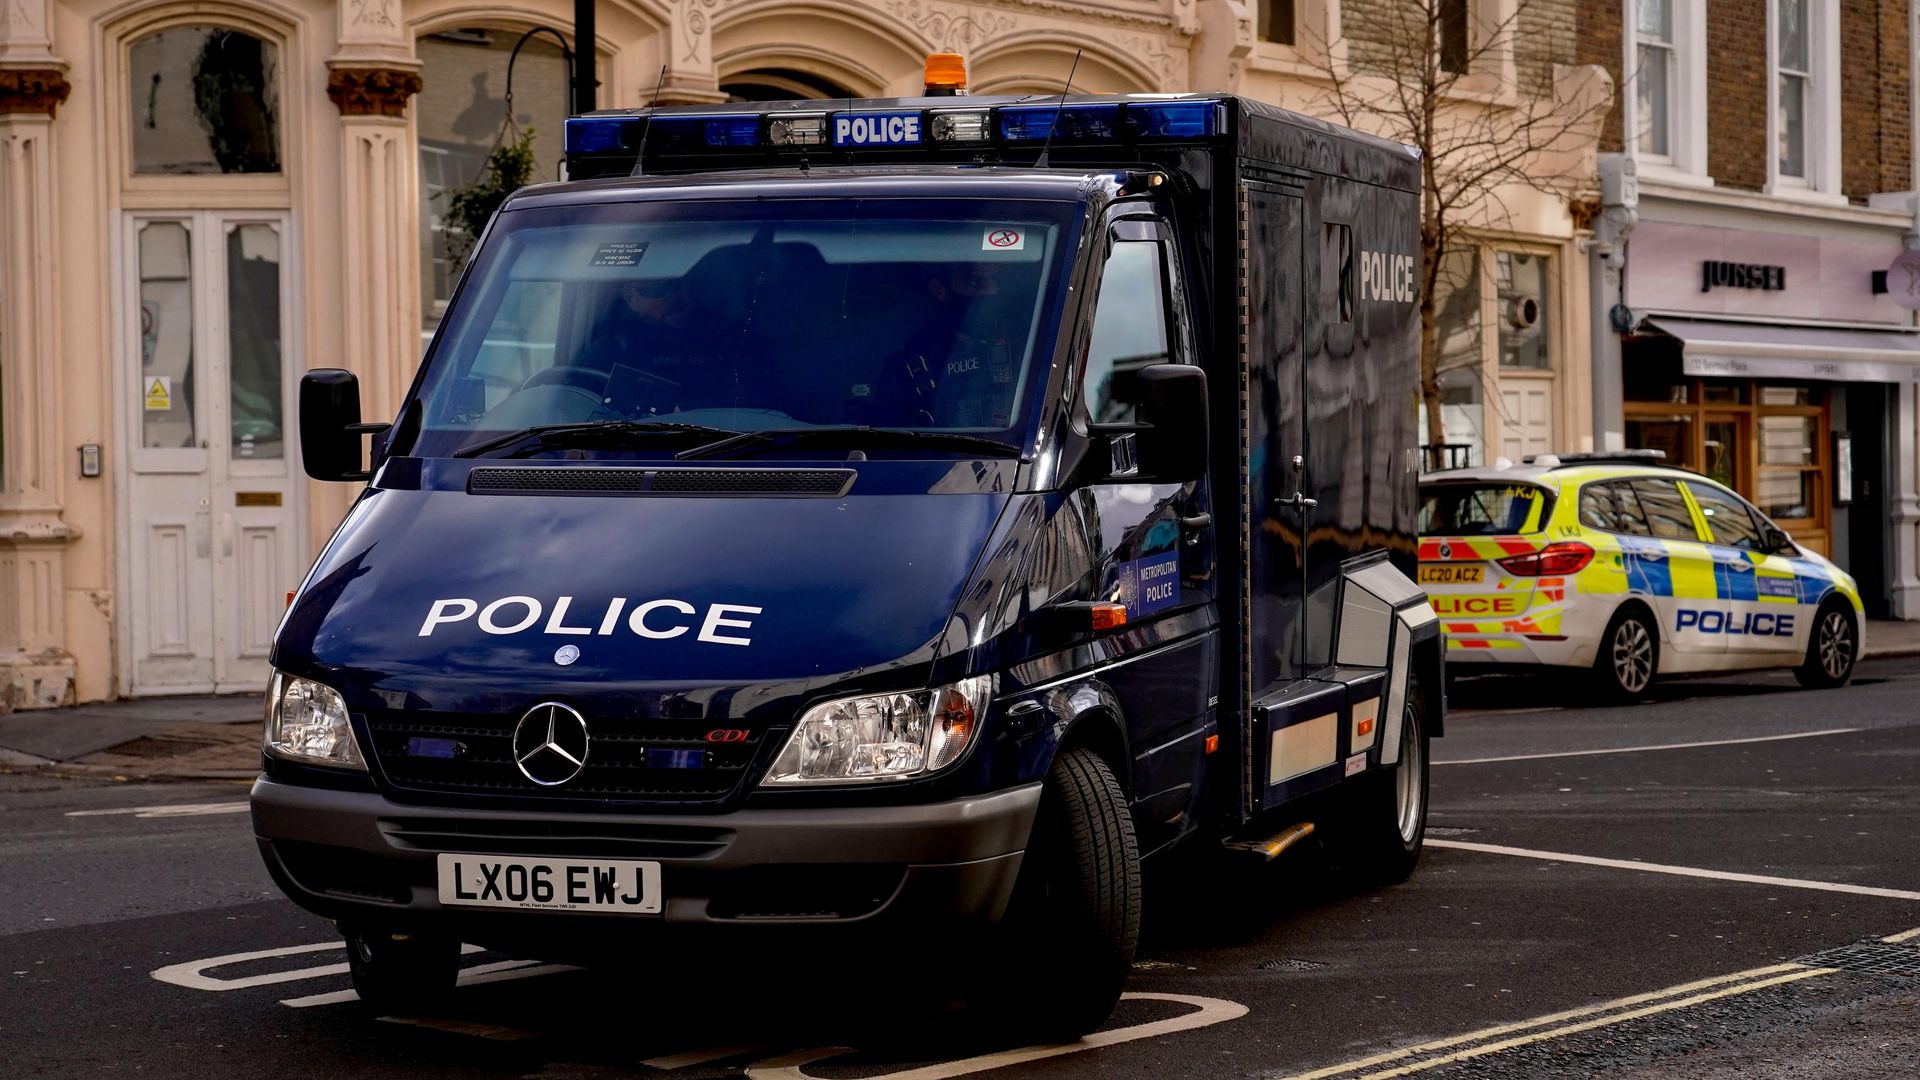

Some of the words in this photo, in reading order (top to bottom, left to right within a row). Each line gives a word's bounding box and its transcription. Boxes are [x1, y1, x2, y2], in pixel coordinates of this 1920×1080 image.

[837, 117, 919, 144] POLICE
[1361, 250, 1414, 303] POLICE
[947, 358, 980, 375] POLICE
[1559, 525, 1582, 537] LKJ
[1140, 560, 1177, 581] METROPOLITAN
[1421, 568, 1452, 581] LC20
[1455, 568, 1479, 581] ACZ
[1146, 582, 1173, 603] POLICE
[1433, 598, 1515, 613] LICE
[418, 595, 763, 646] POLICE
[1676, 609, 1795, 637] POLICE
[706, 729, 750, 742] CDI
[454, 862, 554, 903] LX06
[566, 866, 644, 905] EWJ
